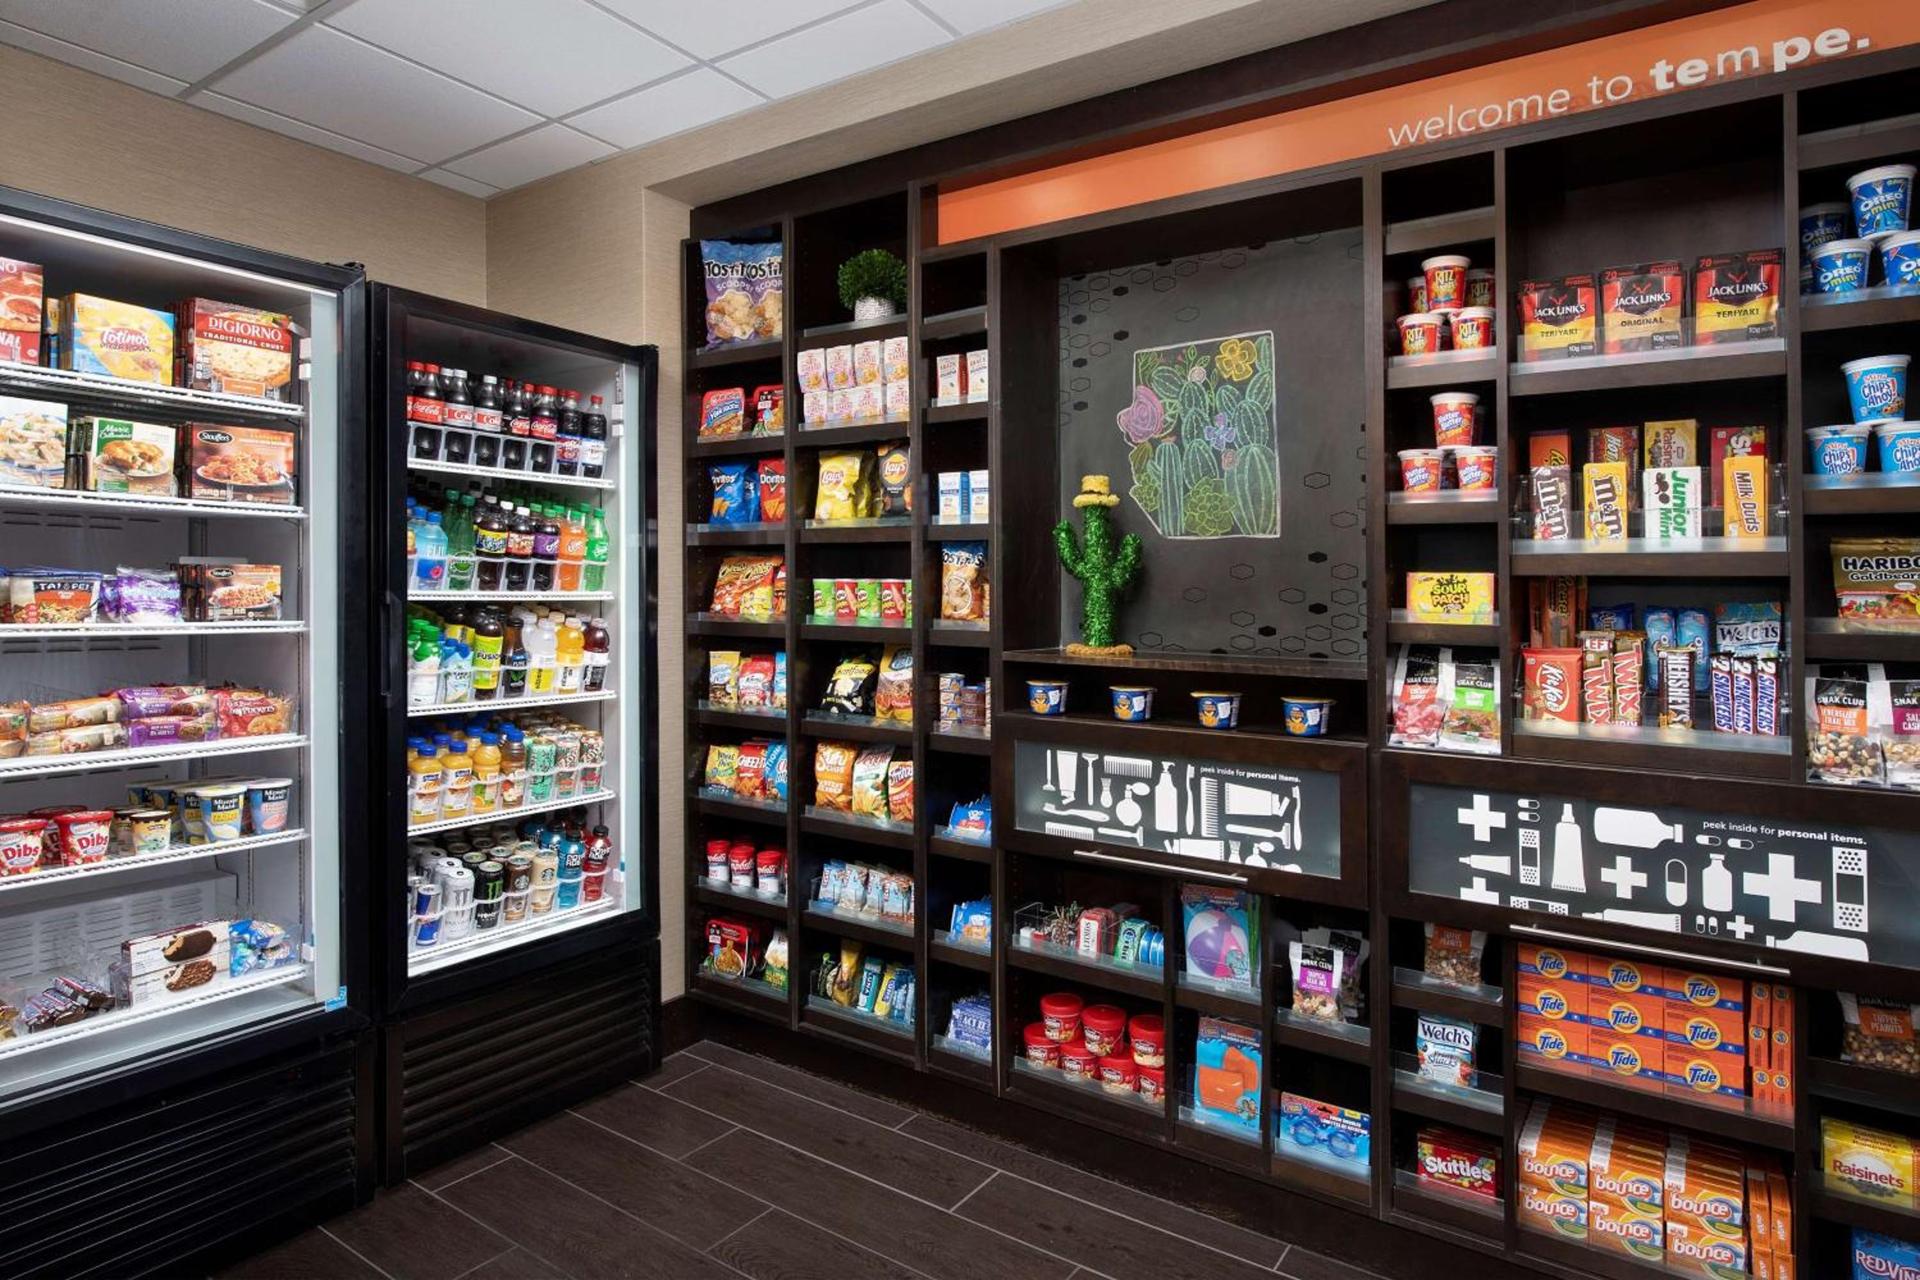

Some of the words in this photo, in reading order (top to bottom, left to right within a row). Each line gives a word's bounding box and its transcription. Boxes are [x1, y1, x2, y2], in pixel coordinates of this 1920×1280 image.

[1388, 87, 1571, 147] welcome
[1587, 73, 1633, 106] to
[1649, 26, 1871, 92] tempe.
[1860, 191, 1903, 212] OREO
[1869, 201, 1898, 216] mini
[1819, 263, 1862, 285] OREO
[1828, 272, 1857, 287] mini
[1708, 285, 1735, 297] JACK
[1736, 282, 1769, 294] LINK'S
[1615, 297, 1640, 308] JACK
[1640, 292, 1671, 305] LINK'S
[1534, 306, 1556, 318] JACK
[1620, 316, 1664, 327] ORIGINAL
[1716, 307, 1760, 319] TERIYAKI
[208, 316, 282, 342] DIGIORNO
[1540, 328, 1579, 338] TERIYAKI
[203, 331, 258, 347] TRADITIONAL
[260, 341, 285, 351] CRUST
[1862, 380, 1891, 399] Chips
[1823, 449, 1851, 467] Chips
[1735, 471, 1754, 500] Milk
[1671, 470, 1689, 536] Junior
[1741, 502, 1759, 533] Duds
[1432, 584, 1467, 595] SOUR
[1431, 594, 1470, 605] PATCH
[1614, 639, 1643, 715] TWIX
[1583, 658, 1612, 725] TWIX
[1667, 655, 1690, 723] HERSHEY'S
[1714, 673, 1733, 731] SNICKERS
[1735, 675, 1752, 733] SNICKERS
[1758, 675, 1775, 733] SNICKERS
[1842, 696, 1865, 707] CLUB
[1894, 697, 1918, 706] SNAK
[1200, 764, 1215, 776] peek
[1217, 766, 1234, 777] inside
[1235, 768, 1246, 778] for
[1246, 770, 1278, 783] personal
[1278, 773, 1302, 783] items.
[77, 831, 109, 849] Dibs
[1703, 820, 1727, 833] peek
[1728, 821, 1758, 834] inside
[1759, 825, 1777, 836] for
[1777, 827, 1828, 843] personal
[1830, 830, 1868, 846] items.
[4, 843, 40, 861] Dibs
[1539, 955, 1563, 970] Tide
[1611, 968, 1638, 983] Tide
[1688, 982, 1717, 997] Tide
[1539, 996, 1564, 1011] Tide
[1612, 1009, 1638, 1025] Tide
[1421, 1023, 1470, 1047] Welch's
[1689, 1025, 1718, 1041] Tide
[1539, 1036, 1564, 1051] Tide
[1612, 1052, 1638, 1068] Tide
[1689, 1067, 1718, 1084] Tide
[1425, 1156, 1492, 1182] Skittles
[1523, 1158, 1576, 1180] bounce
[1833, 1157, 1904, 1189] Raisinets
[1595, 1173, 1650, 1196] bounce
[1524, 1194, 1577, 1217] bounce
[1670, 1192, 1730, 1217] bounce
[1595, 1214, 1650, 1237] bounce
[1672, 1237, 1734, 1262] bounce
